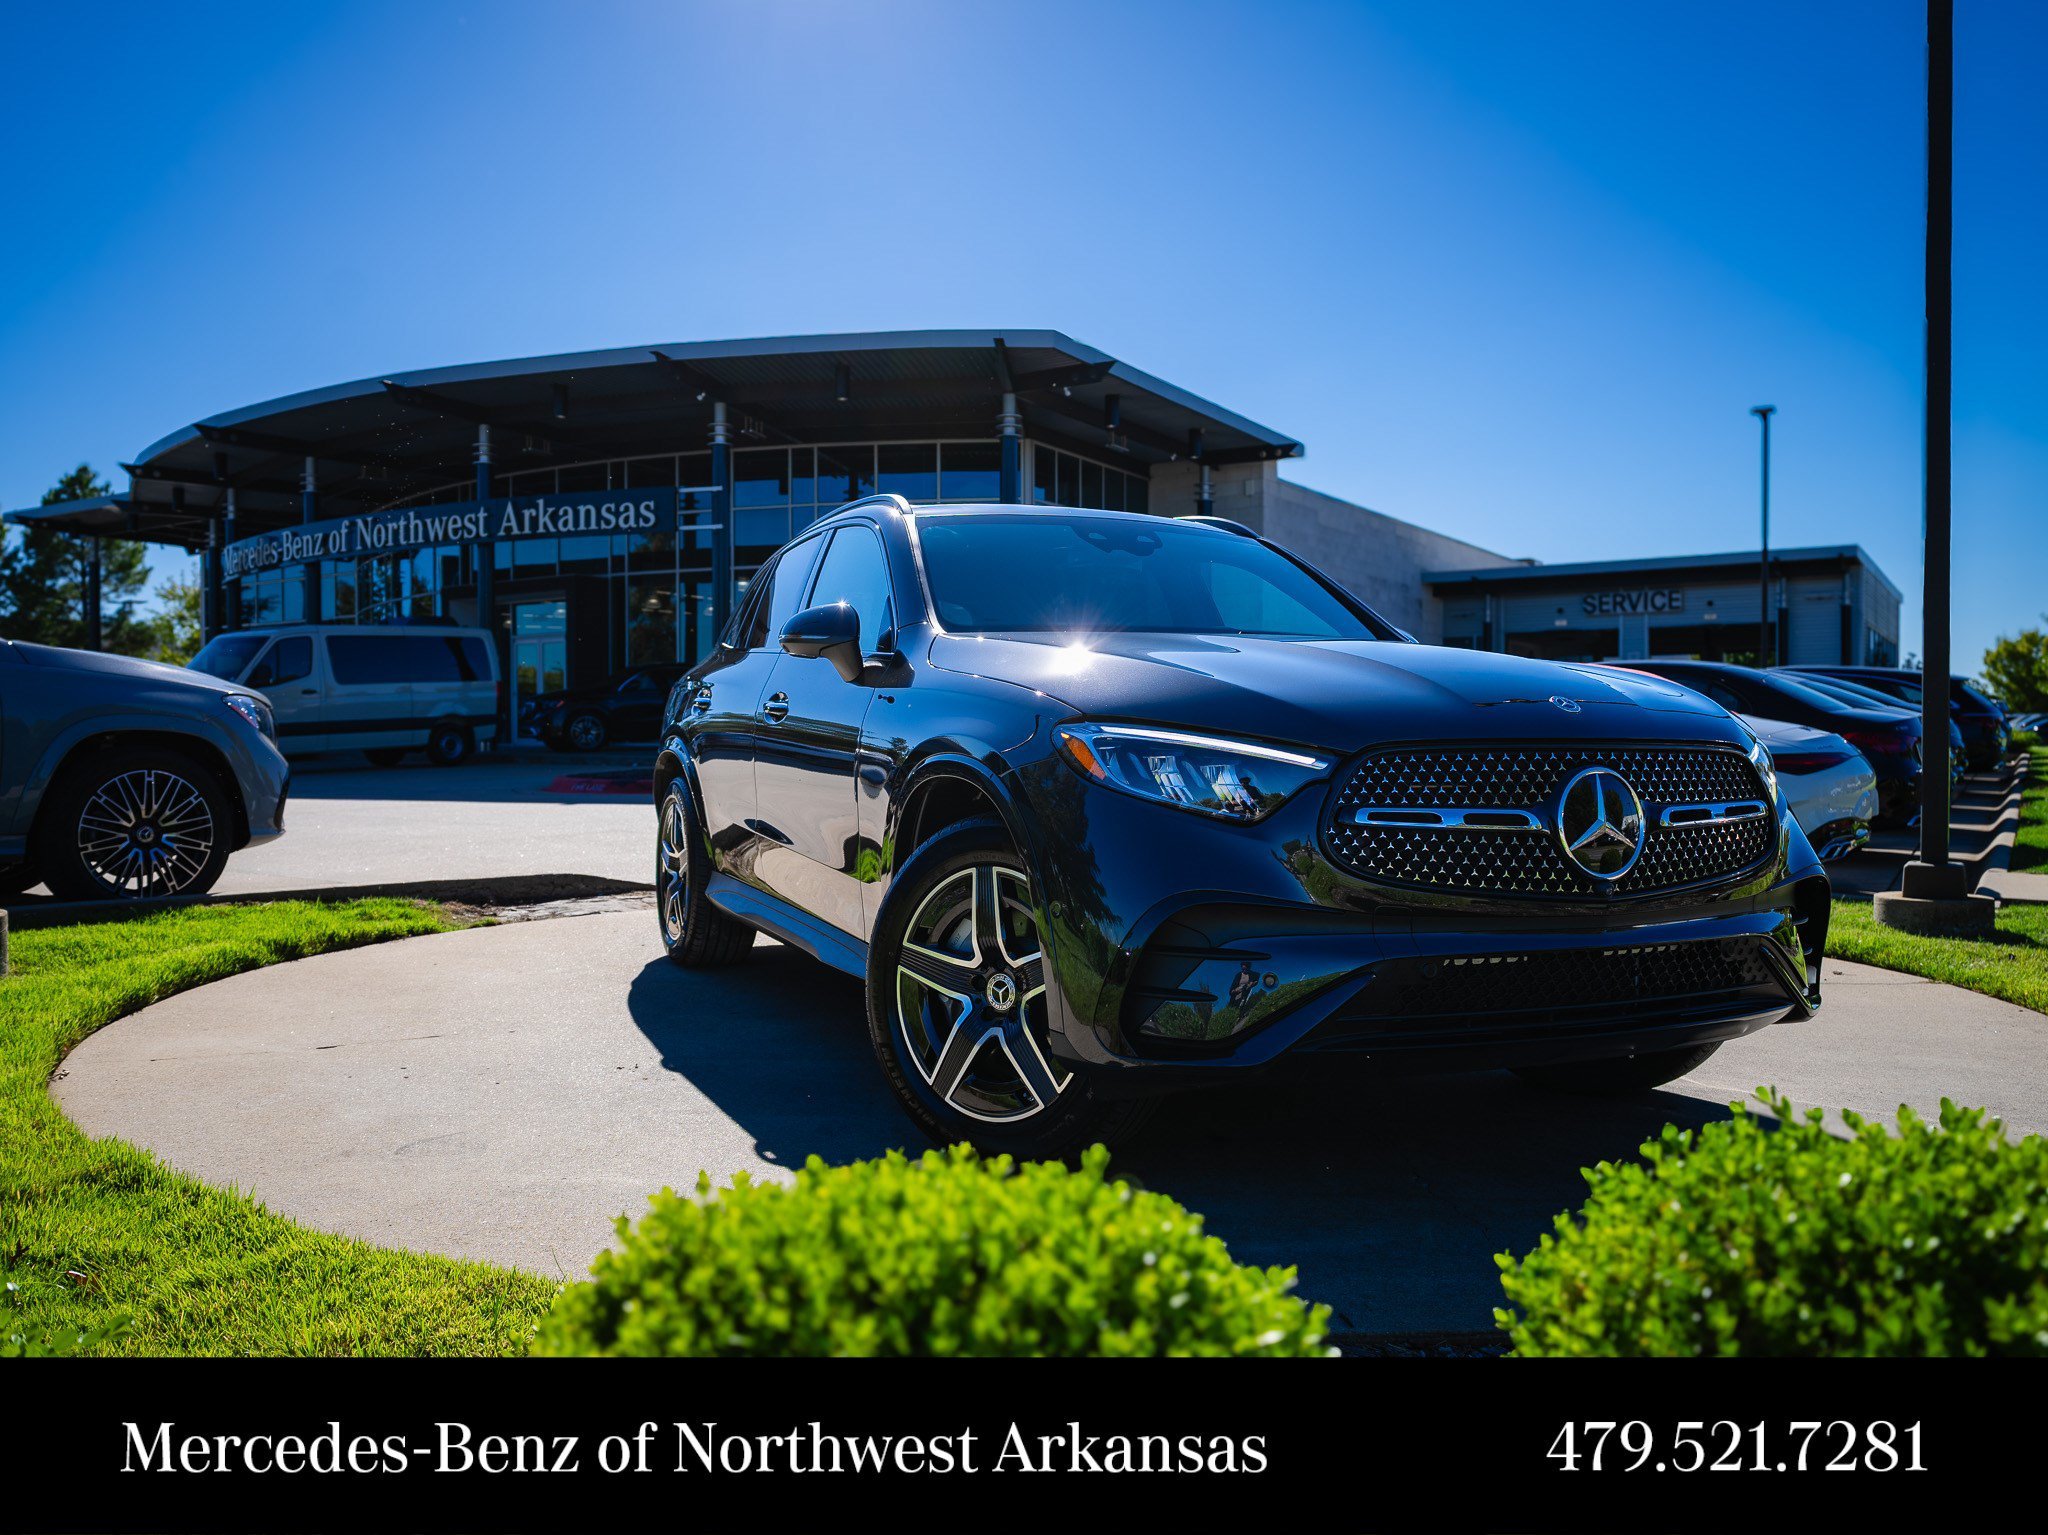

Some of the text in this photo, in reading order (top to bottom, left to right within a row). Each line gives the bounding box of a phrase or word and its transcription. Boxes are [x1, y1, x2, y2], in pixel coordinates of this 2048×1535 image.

[223, 498, 657, 575] Mercedes-Benz of Northwest Arkansas
[1583, 590, 1681, 614] SERVICE
